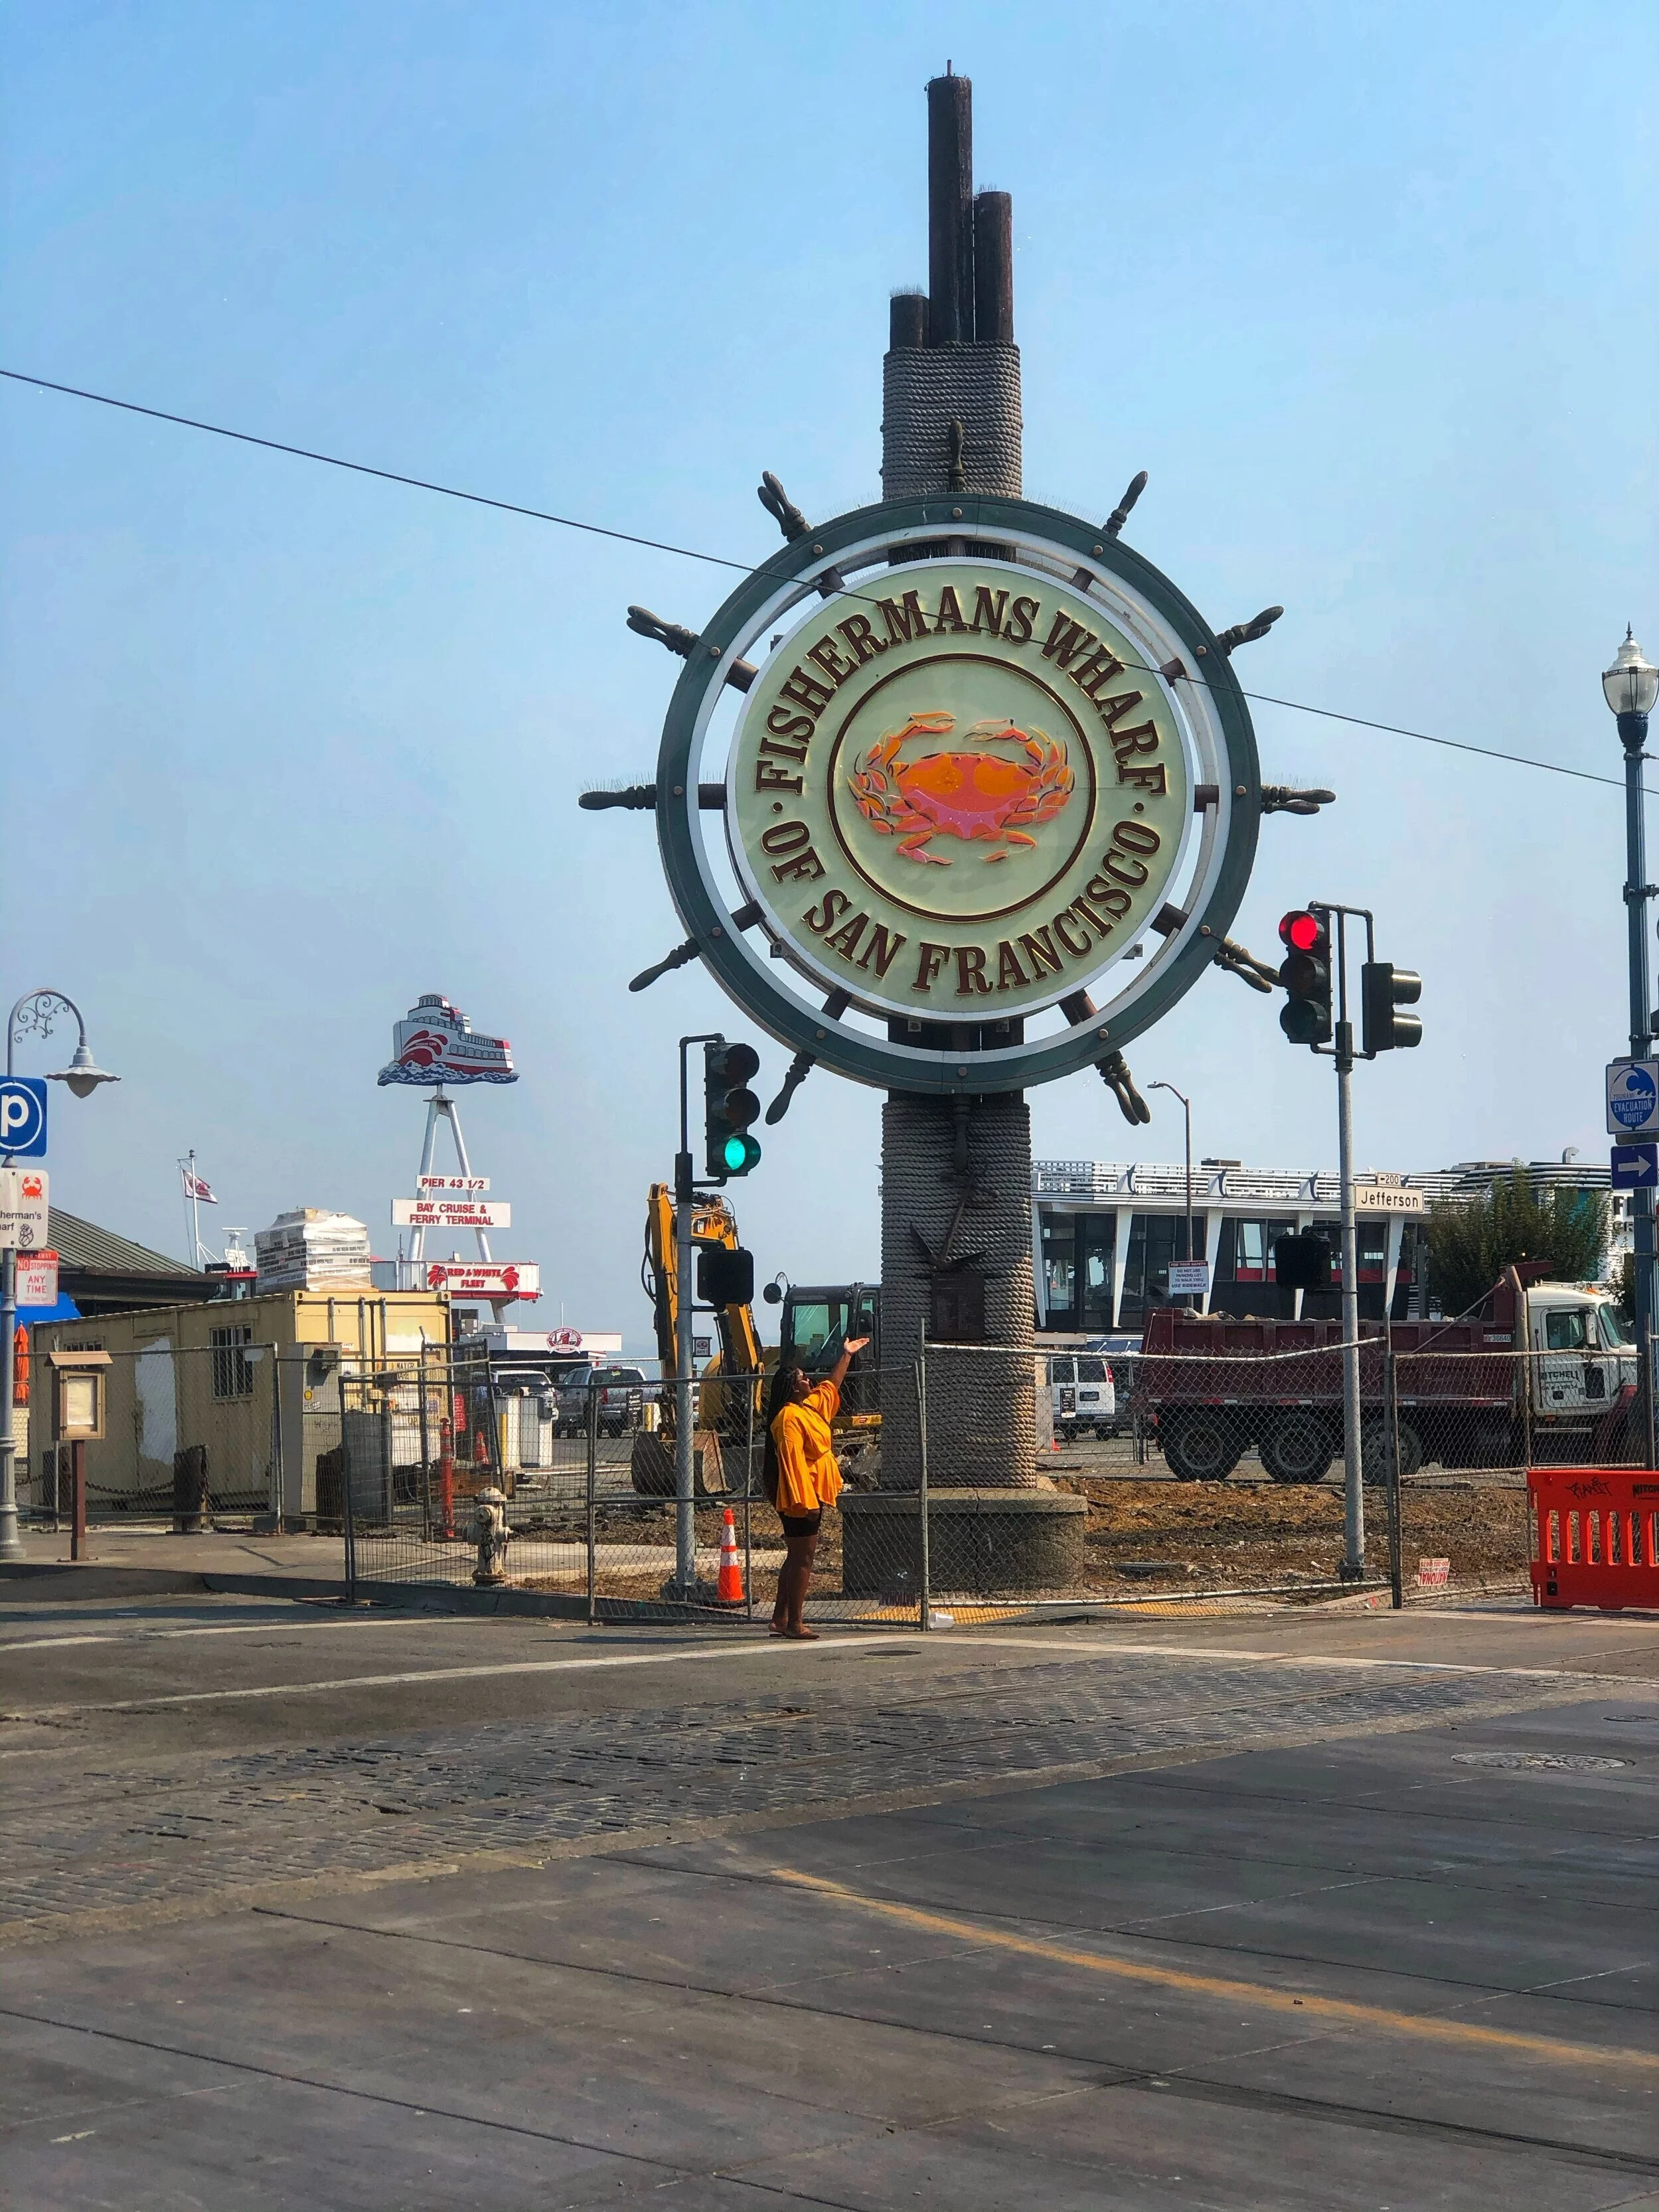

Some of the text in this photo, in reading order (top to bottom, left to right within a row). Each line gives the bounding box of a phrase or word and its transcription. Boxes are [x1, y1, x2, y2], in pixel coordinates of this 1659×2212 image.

[755, 585, 1168, 796] FISHERMANS WHARF
[761, 820, 1162, 997] OF SAN FRANCISCO
[1614, 1100, 1652, 1113] EVACUATION
[1623, 1112, 1643, 1123] ROUTE
[421, 1177, 485, 1190] PIER 43 1/2
[1385, 1175, 1399, 1185] 200
[1361, 1191, 1419, 1208] Jefferson
[416, 1203, 487, 1215] BAY CRUISE &
[409, 1214, 495, 1226] FERRY TERMINAL
[17, 1259, 29, 1270] NO
[447, 1268, 465, 1277] RED
[472, 1268, 502, 1278] WHITE
[28, 1275, 46, 1284] ANY
[460, 1280, 486, 1289] FLEET
[27, 1285, 47, 1293] TIME
[1419, 1572, 1448, 1585] NATIONAL
